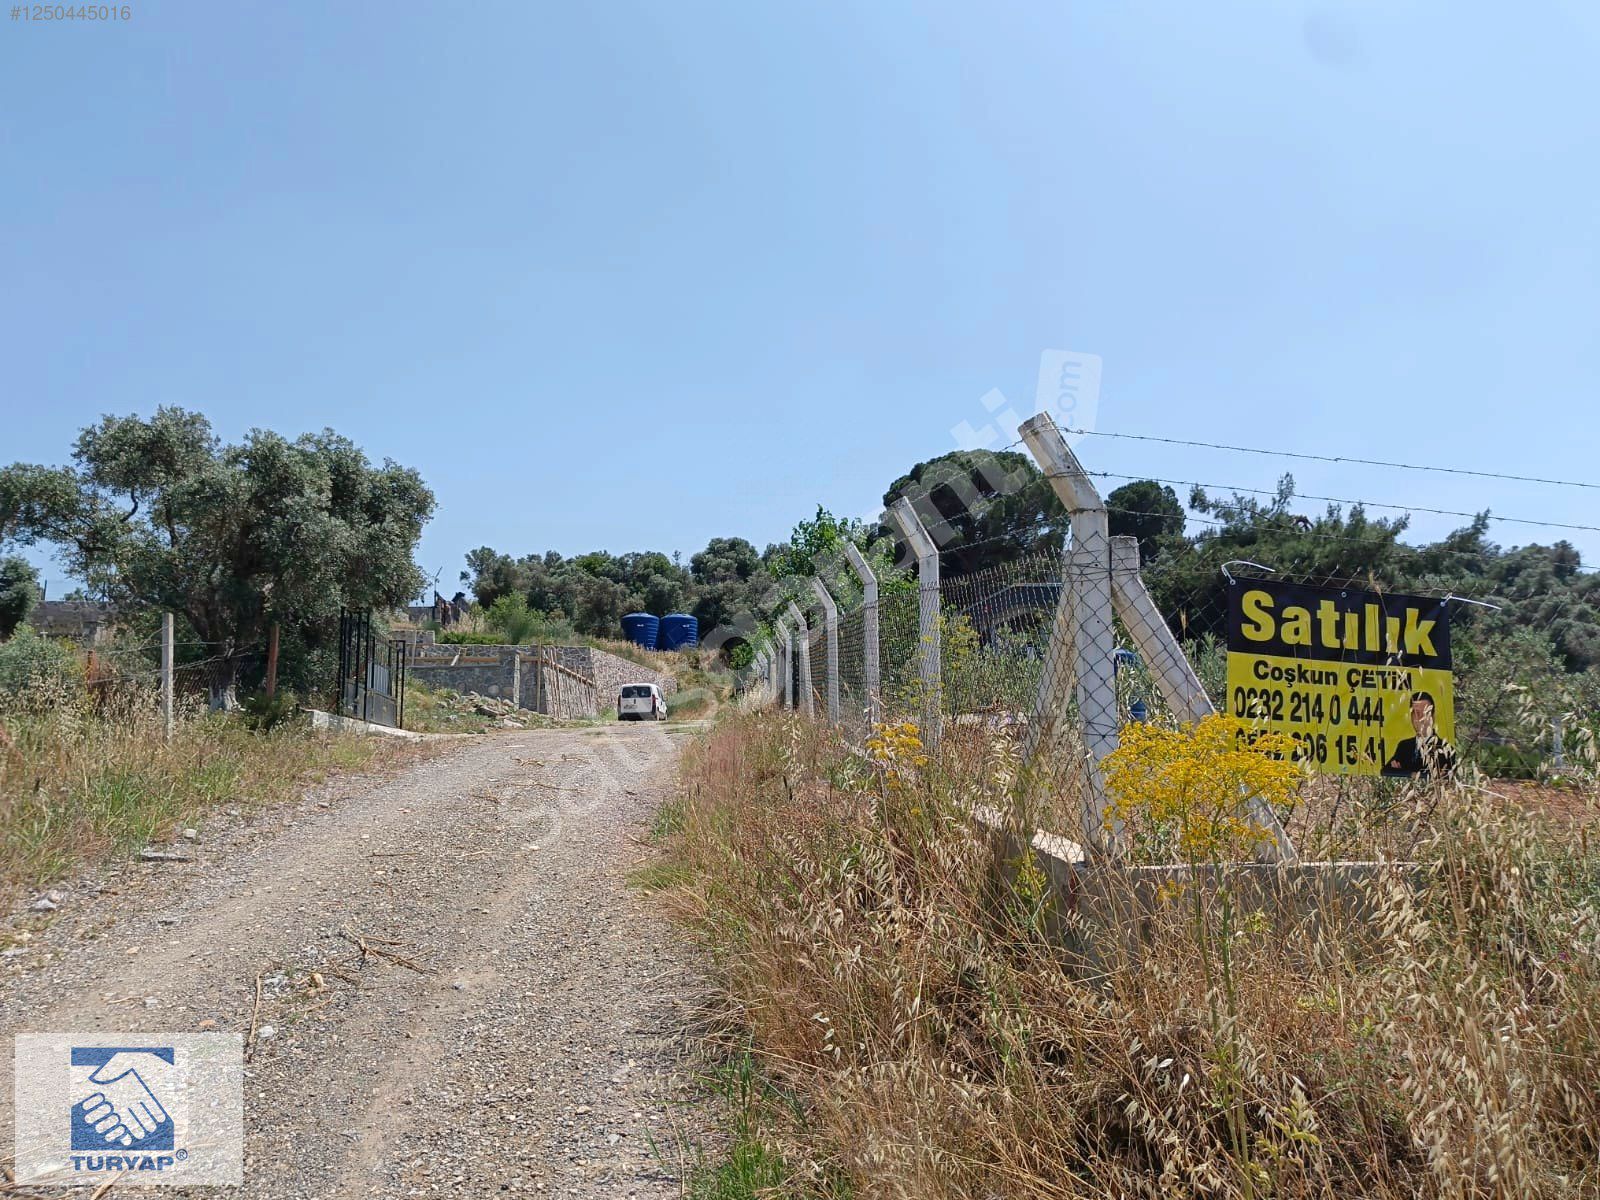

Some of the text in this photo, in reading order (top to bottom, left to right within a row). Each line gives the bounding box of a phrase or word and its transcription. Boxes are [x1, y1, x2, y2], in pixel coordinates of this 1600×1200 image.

[1241, 590, 1438, 657] Satılık
[1253, 660, 1338, 688] Coşkun
[1234, 686, 1284, 721] 0232
[1290, 691, 1324, 724] 214
[1348, 695, 1385, 727] 444
